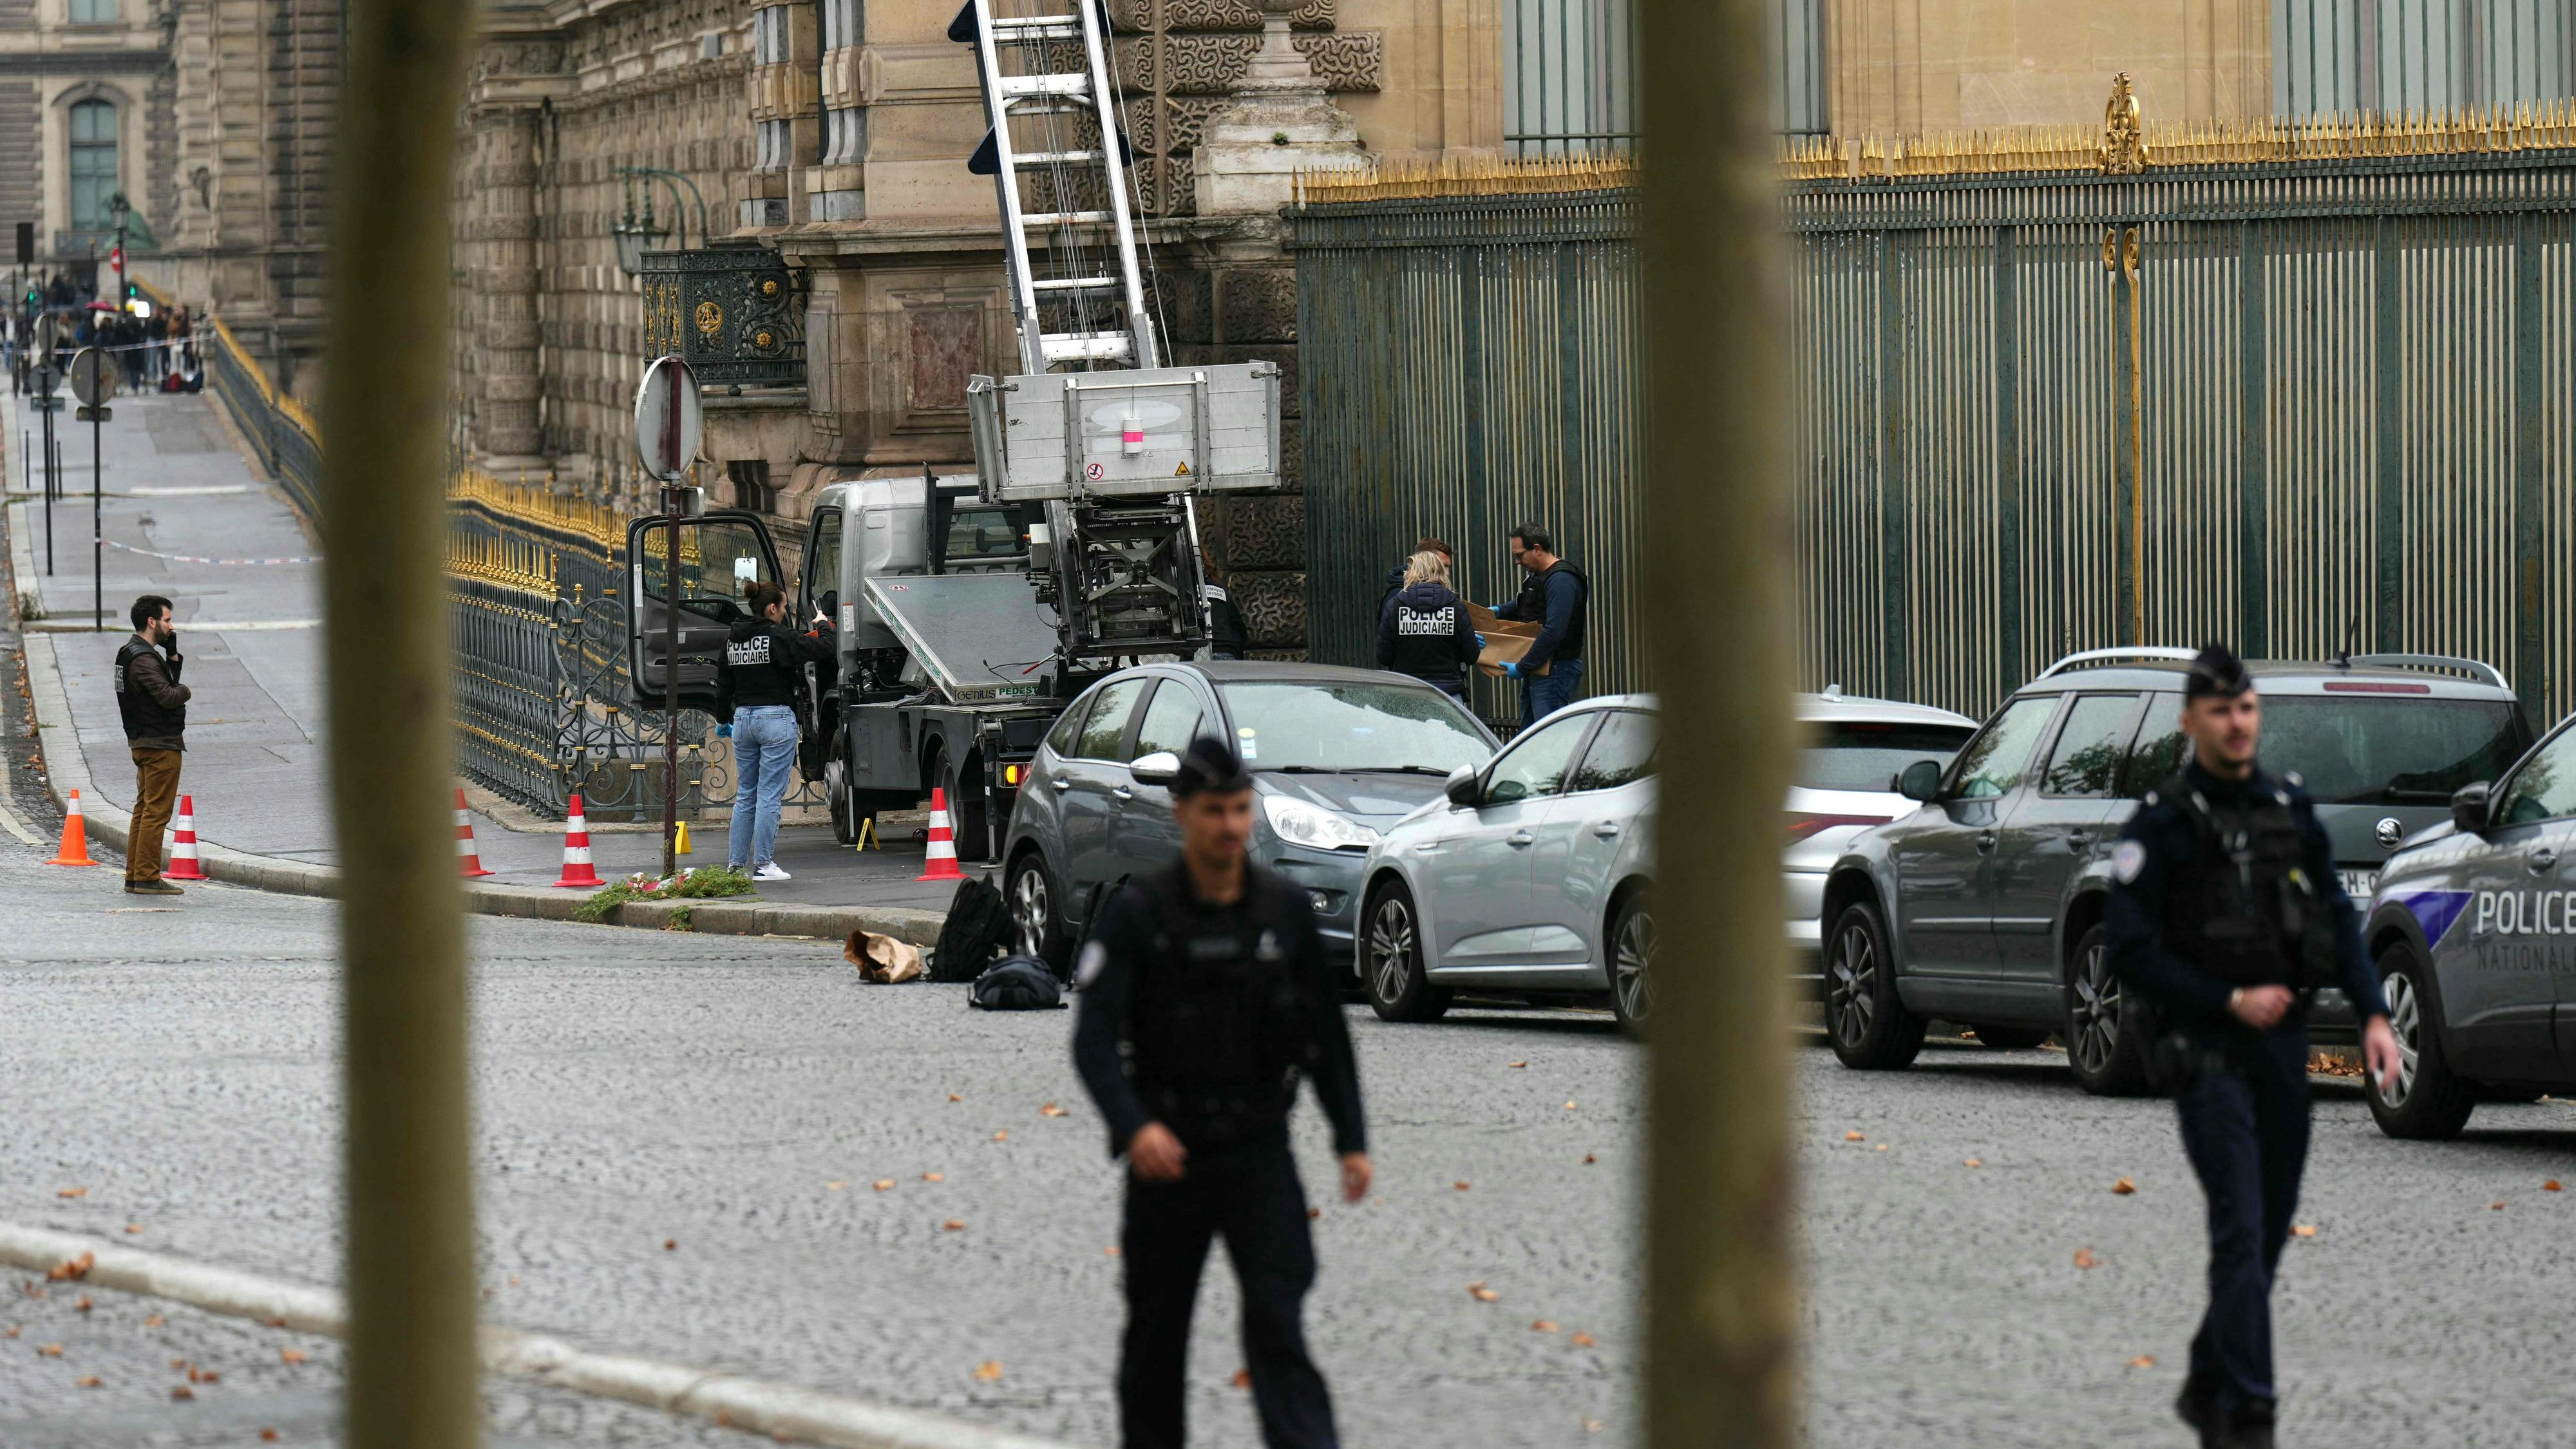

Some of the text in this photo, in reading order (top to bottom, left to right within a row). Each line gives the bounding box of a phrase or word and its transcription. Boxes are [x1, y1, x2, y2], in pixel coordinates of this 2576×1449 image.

[1400, 608, 1453, 621] POLICE
[1400, 622, 1453, 634] JUDICIAIRE
[728, 638, 768, 652] POLICE
[2477, 891, 2576, 934] POLICE
[2477, 944, 2576, 971] NATIONAL
